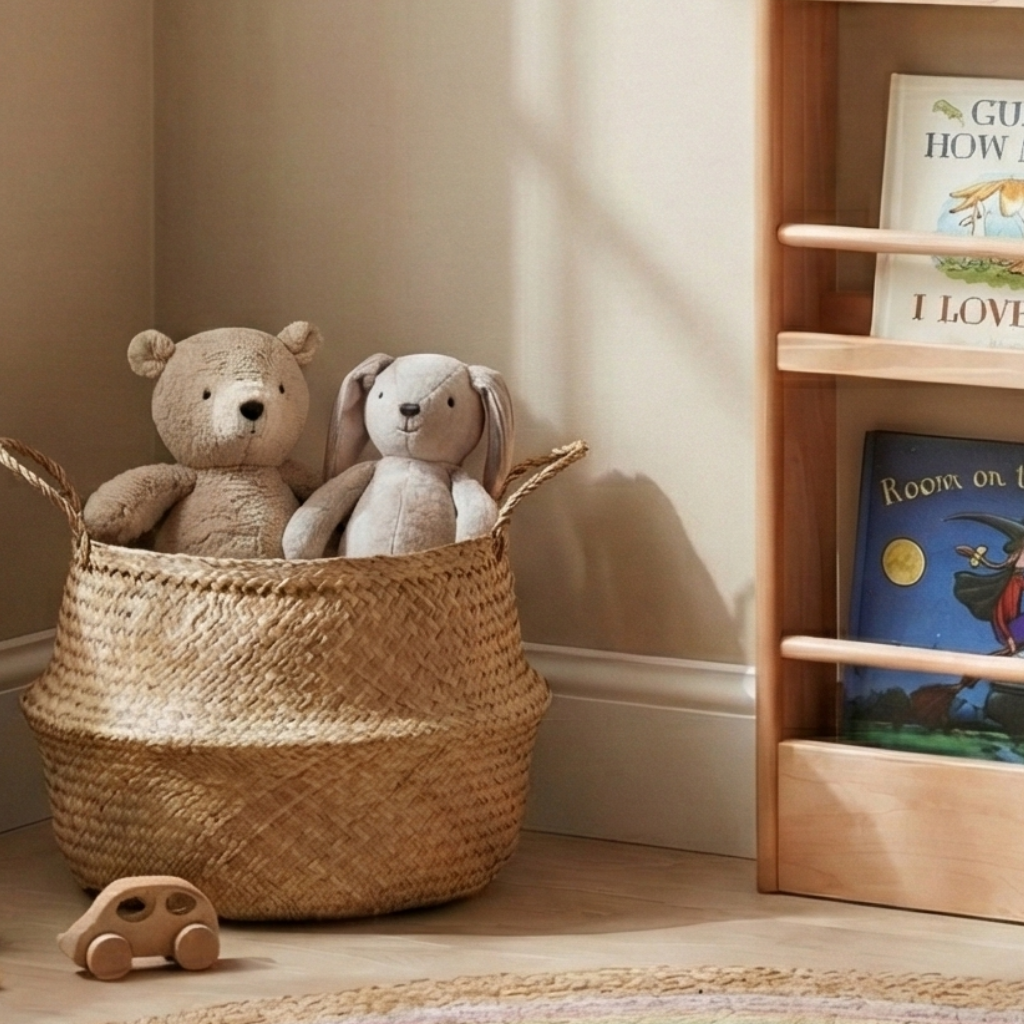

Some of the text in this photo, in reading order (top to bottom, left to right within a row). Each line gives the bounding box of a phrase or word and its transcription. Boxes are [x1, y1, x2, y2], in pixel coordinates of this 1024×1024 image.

[924, 131, 1009, 161] HOW
[912, 293, 926, 320] I
[881, 476, 963, 506] Room
[973, 469, 1006, 488] on
